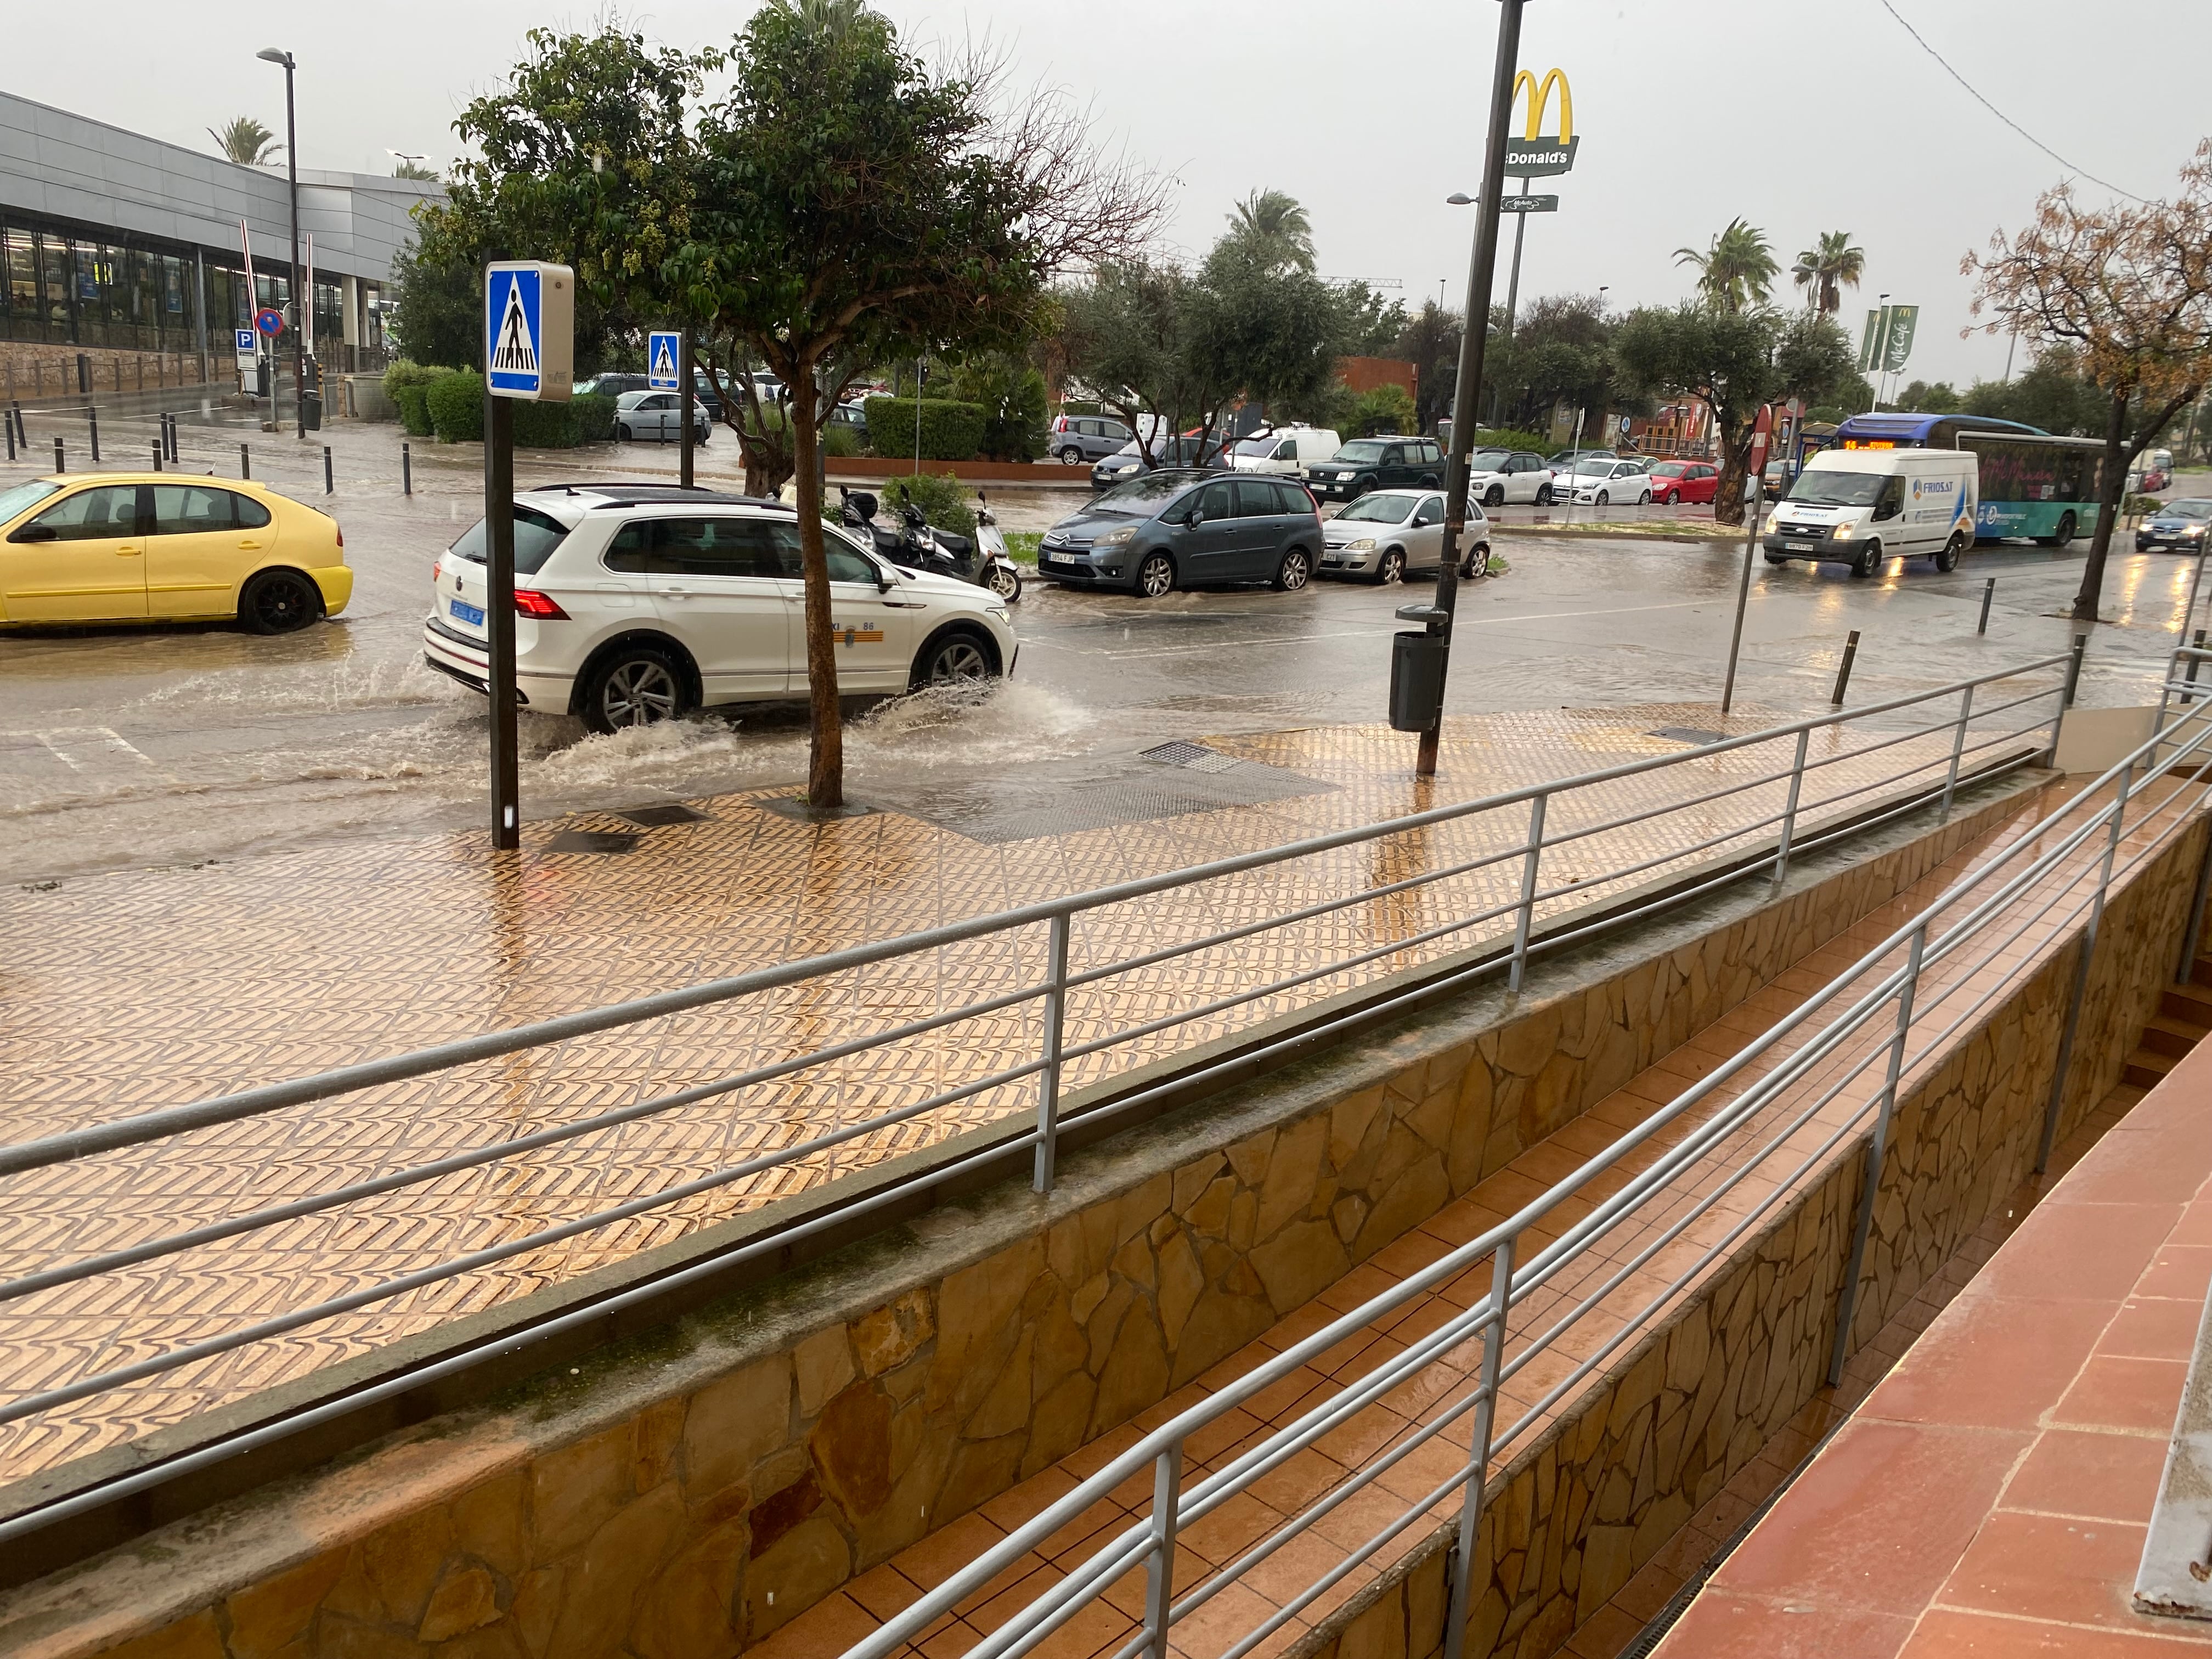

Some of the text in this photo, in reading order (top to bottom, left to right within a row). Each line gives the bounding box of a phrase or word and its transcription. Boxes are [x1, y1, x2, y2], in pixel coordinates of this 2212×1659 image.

[1505, 151, 1568, 165] Donald's
[241, 333, 251, 346] P
[1845, 441, 1857, 450] 14
[1923, 481, 1954, 493] FRIOSAT
[831, 622, 874, 631] XI 86
